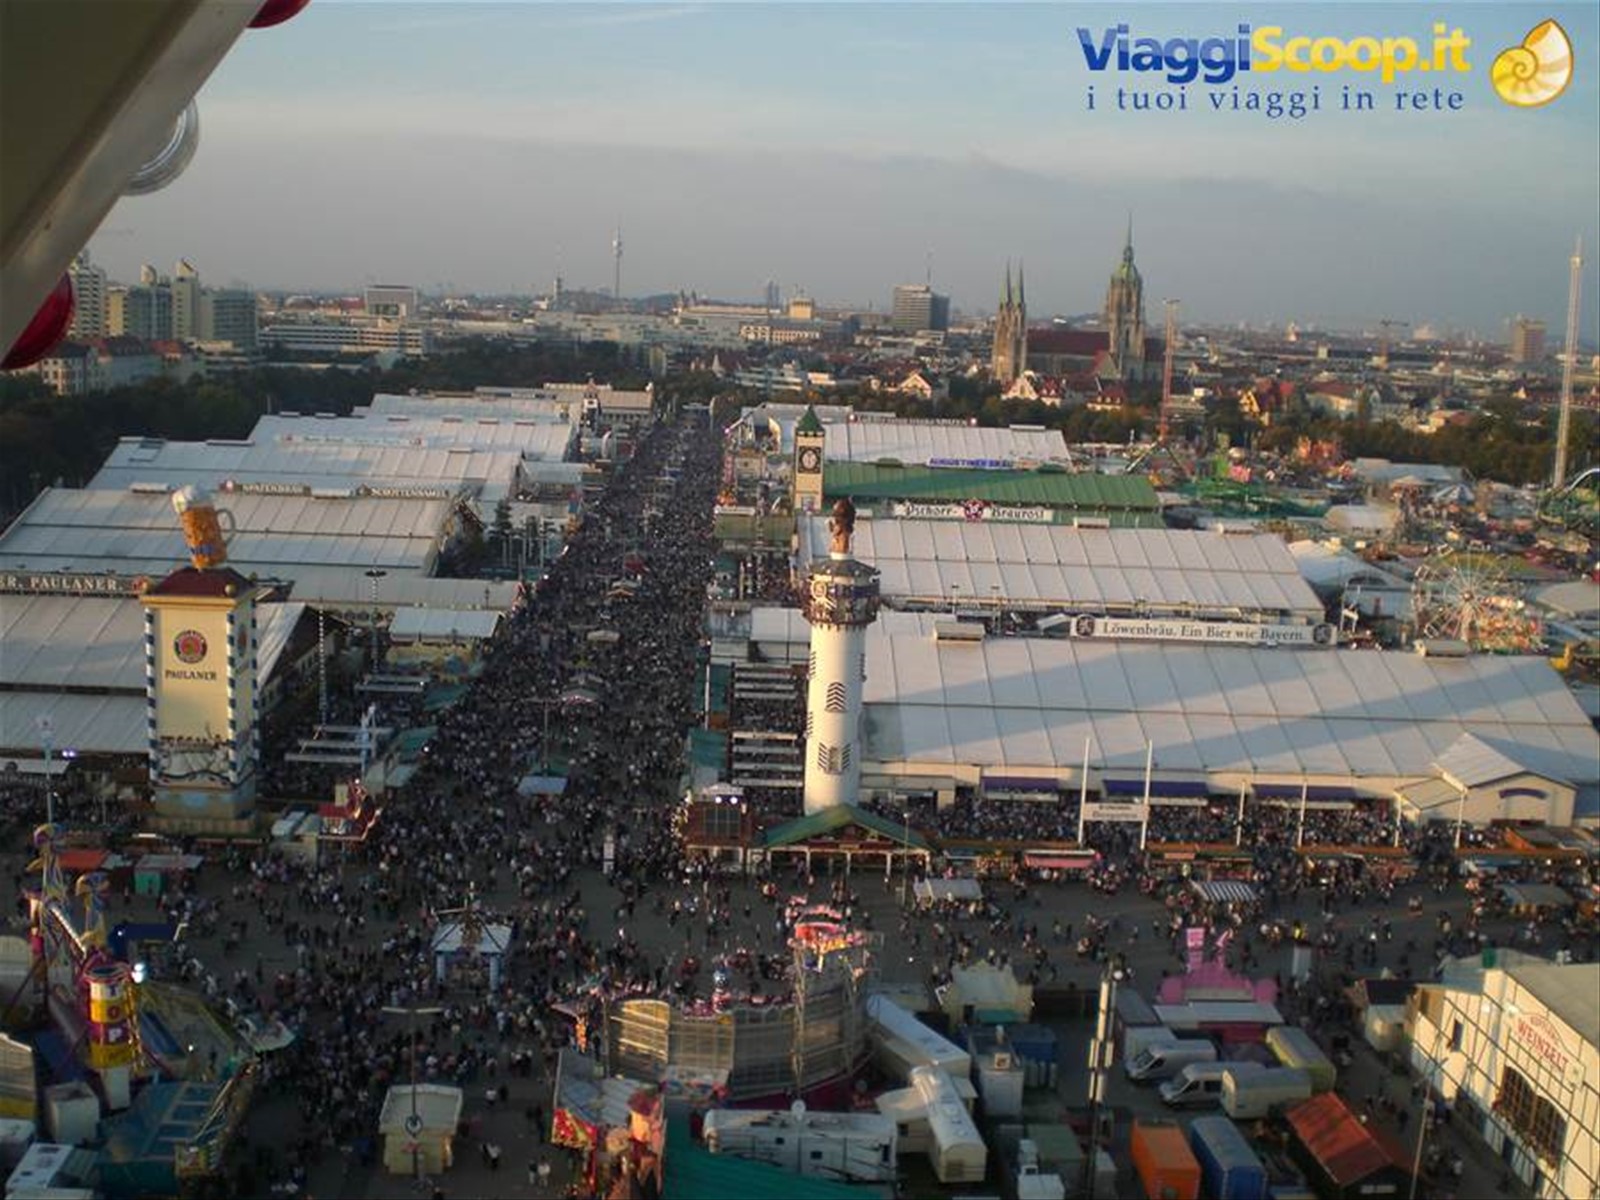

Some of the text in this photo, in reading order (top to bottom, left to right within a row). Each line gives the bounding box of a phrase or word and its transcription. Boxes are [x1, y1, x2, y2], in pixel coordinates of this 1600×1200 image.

[1181, 624, 1202, 636] Ein
[1206, 626, 1232, 638] Bier
[1236, 628, 1256, 639] wie
[165, 670, 217, 681] PAULANER
[1518, 1020, 1569, 1074] WEINZELT
